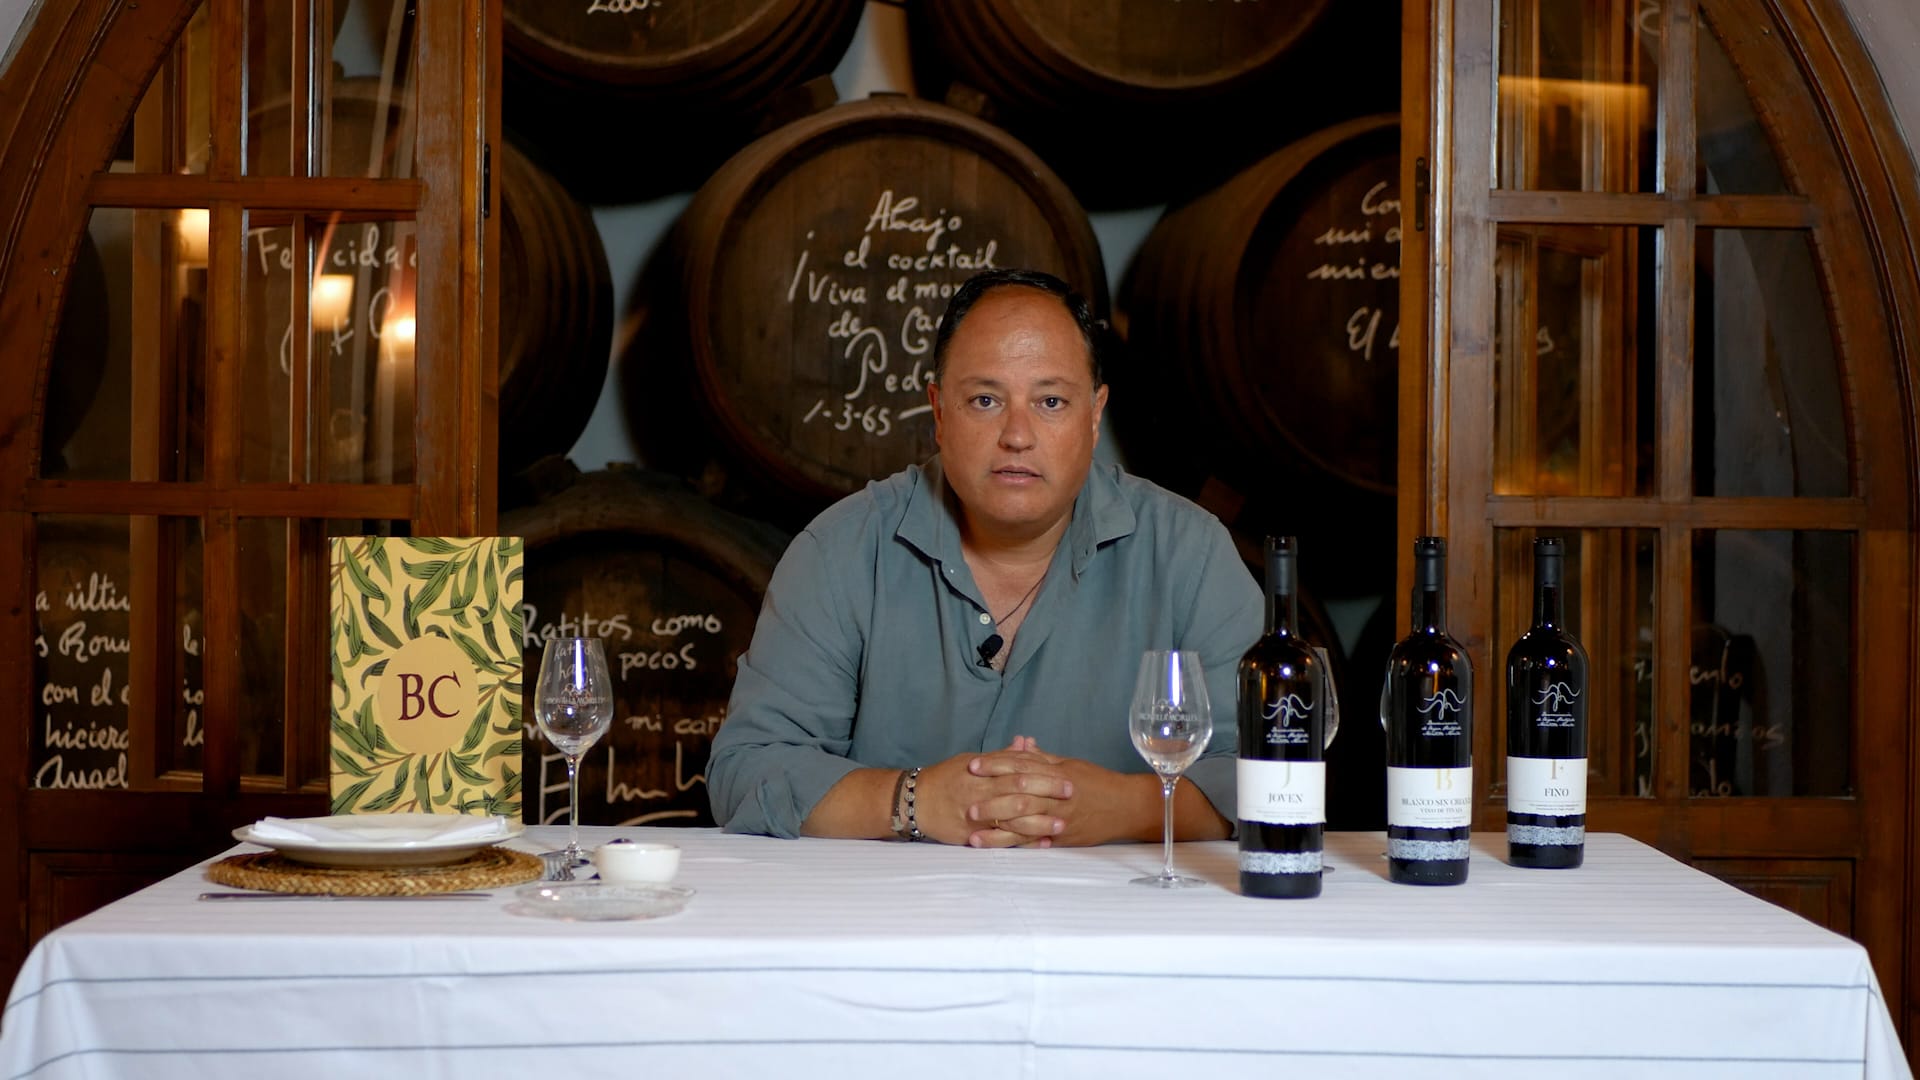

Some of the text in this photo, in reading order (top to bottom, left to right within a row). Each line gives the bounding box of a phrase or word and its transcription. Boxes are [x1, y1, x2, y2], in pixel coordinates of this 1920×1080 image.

[865, 190, 962, 252] Abajo
[844, 235, 998, 271] el cocktail
[886, 276, 908, 303] el
[828, 306, 943, 354] de Ca
[522, 604, 722, 648] Ratitos como
[619, 642, 697, 681] pocos
[42, 682, 79, 705] con
[91, 667, 112, 706] el
[396, 670, 461, 721] BC
[625, 714, 663, 731] mi
[1268, 793, 1303, 805] JOVEN
[1544, 788, 1570, 798] FINO
